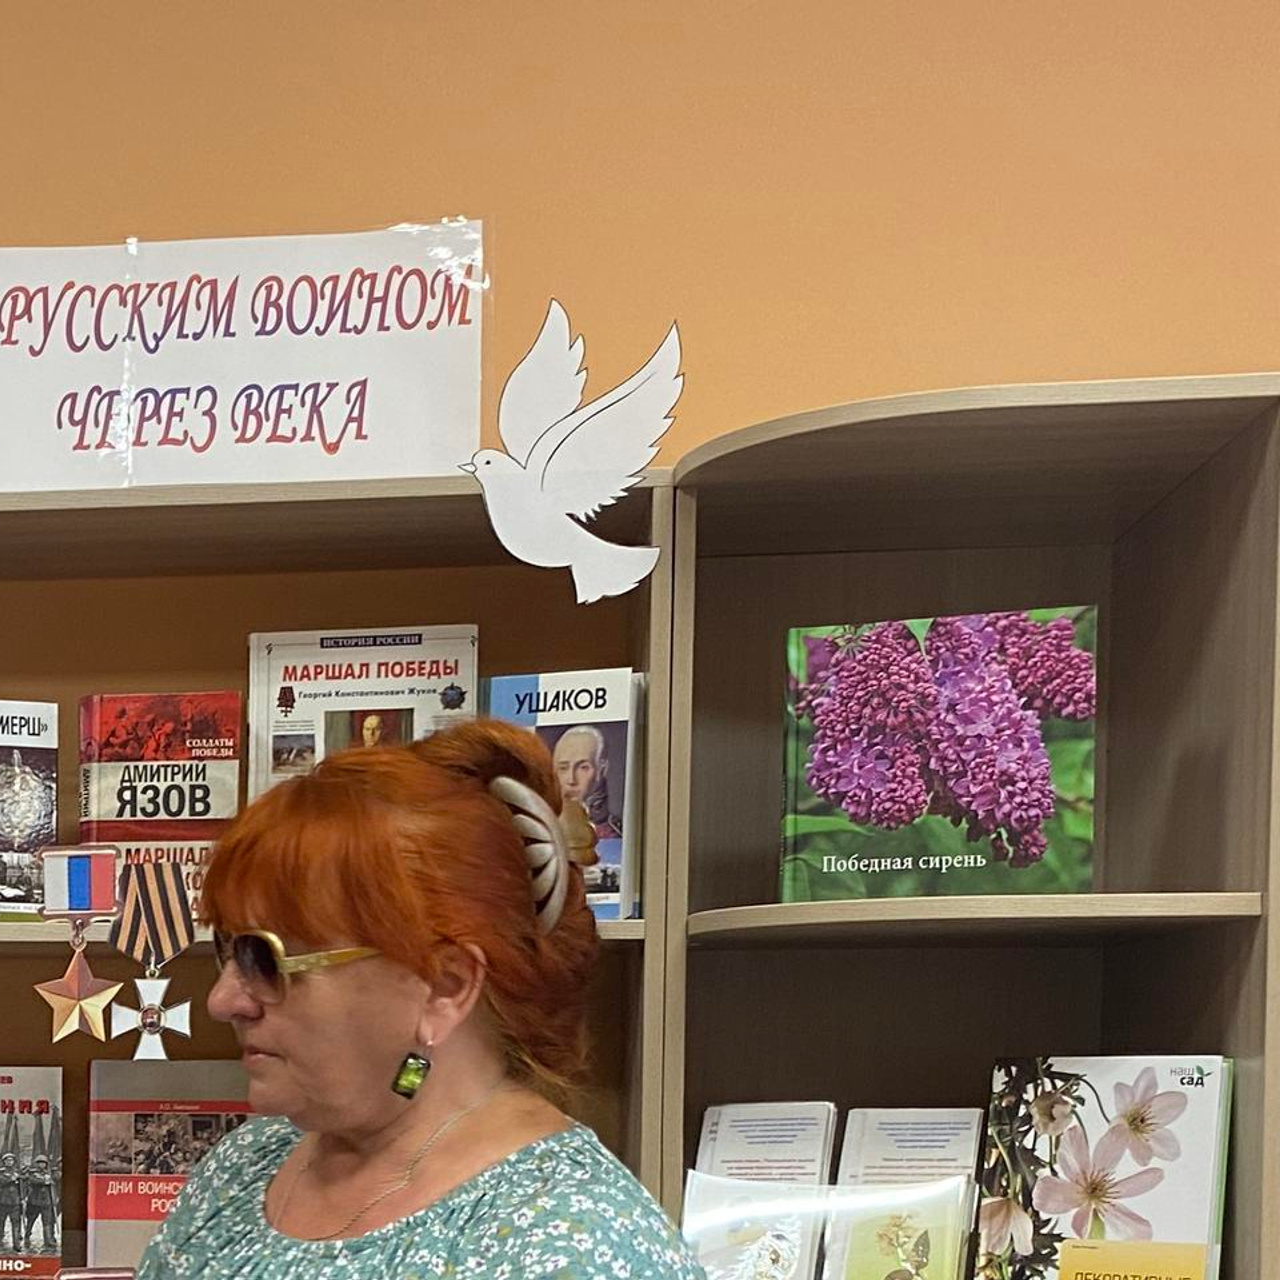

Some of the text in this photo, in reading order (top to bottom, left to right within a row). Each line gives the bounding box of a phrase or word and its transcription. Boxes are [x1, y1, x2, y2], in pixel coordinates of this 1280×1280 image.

[250, 262, 474, 339] ВОИНОМ
[56, 376, 369, 456] ЧЕРЕЗ ВЕКА
[322, 634, 421, 648] ИСТОРИЯ РОССИИ
[282, 659, 459, 682] МАРШАЛ ПОБЕДЫ
[298, 689, 333, 699] Георгий
[514, 687, 608, 714] УШАКОВ
[186, 738, 234, 748] СОЛДАТЫ
[191, 748, 234, 757] ПОБЕДЫ
[120, 761, 207, 786] ДМИТРИЙ
[116, 783, 212, 819] ЯЗОВ
[822, 853, 986, 873] Победная сирень
[1180, 1076, 1205, 1088] сад
[107, 1180, 183, 1196] ДНИ ВОИНС
